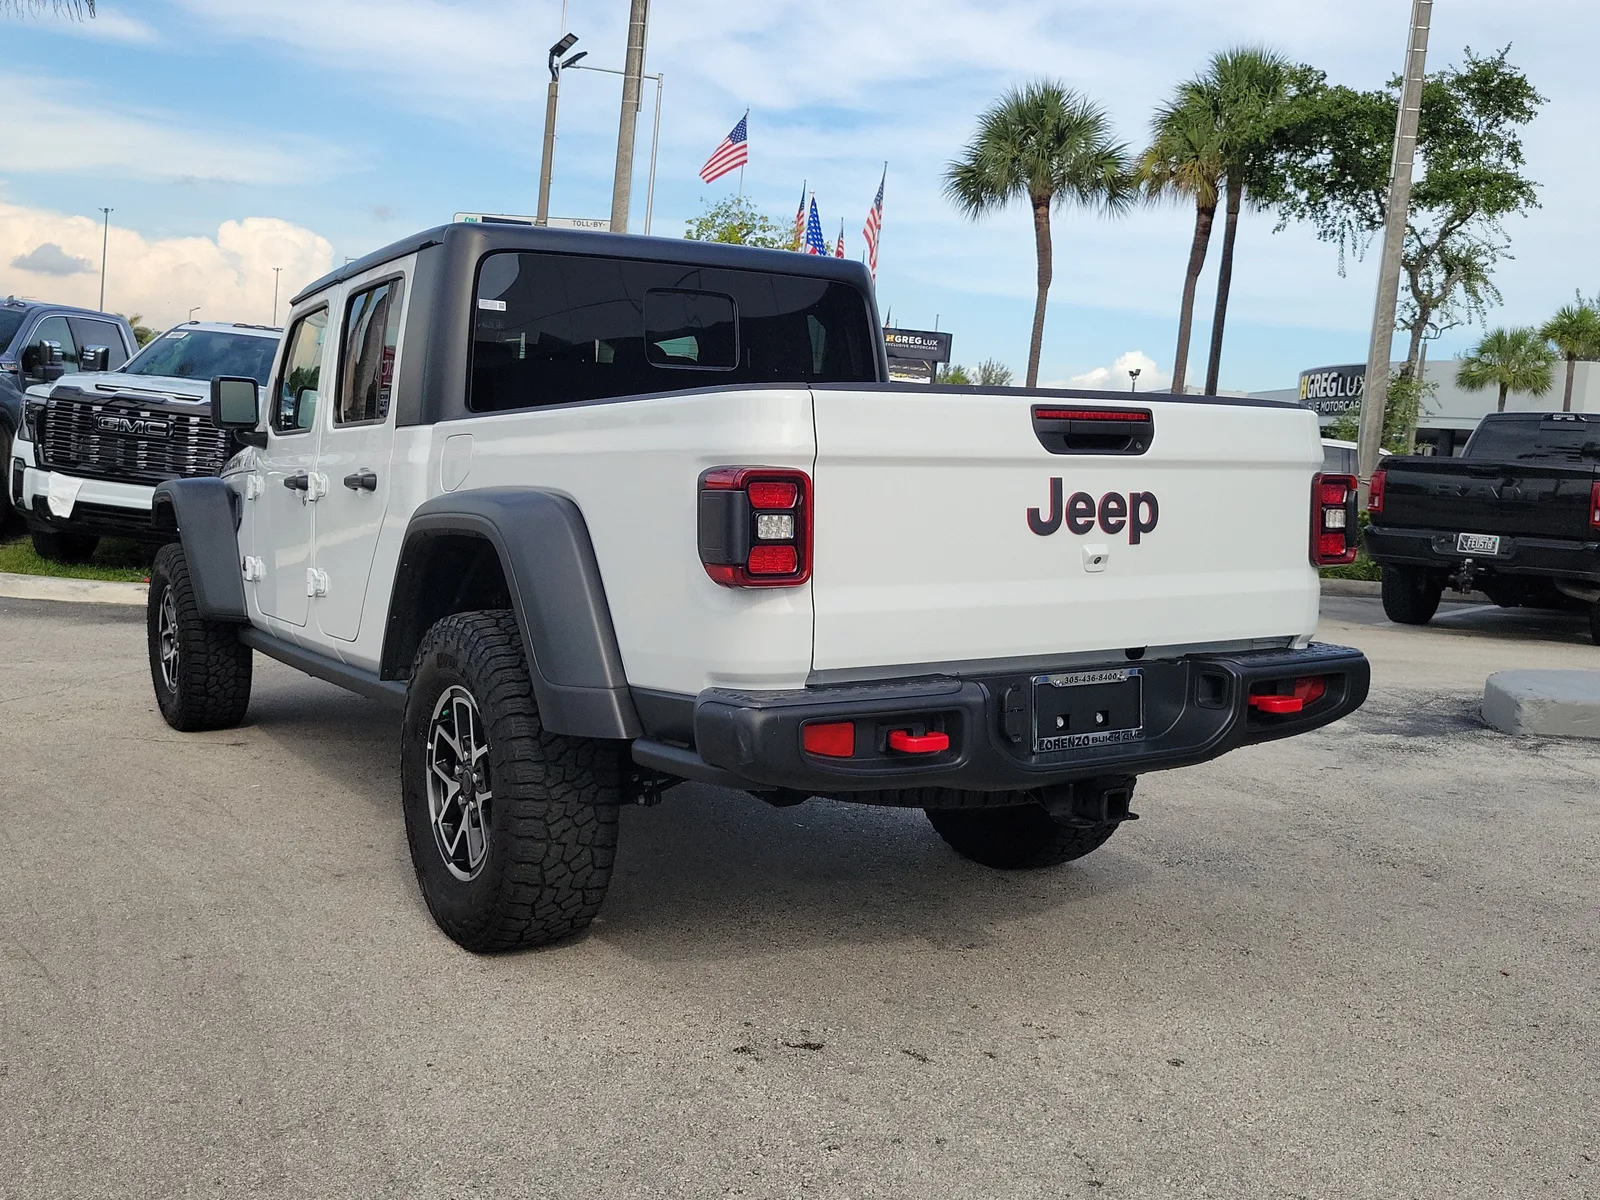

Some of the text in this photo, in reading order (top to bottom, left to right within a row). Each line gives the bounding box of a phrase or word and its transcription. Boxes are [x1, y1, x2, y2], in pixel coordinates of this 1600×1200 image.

[1320, 400, 1361, 412] MOTORCAR
[97, 415, 168, 436] GMC
[1026, 476, 1159, 545] Jeep
[1063, 672, 1118, 684] 305-436-8400
[1039, 735, 1090, 751] LORENZO
[1091, 732, 1120, 744] BUICK
